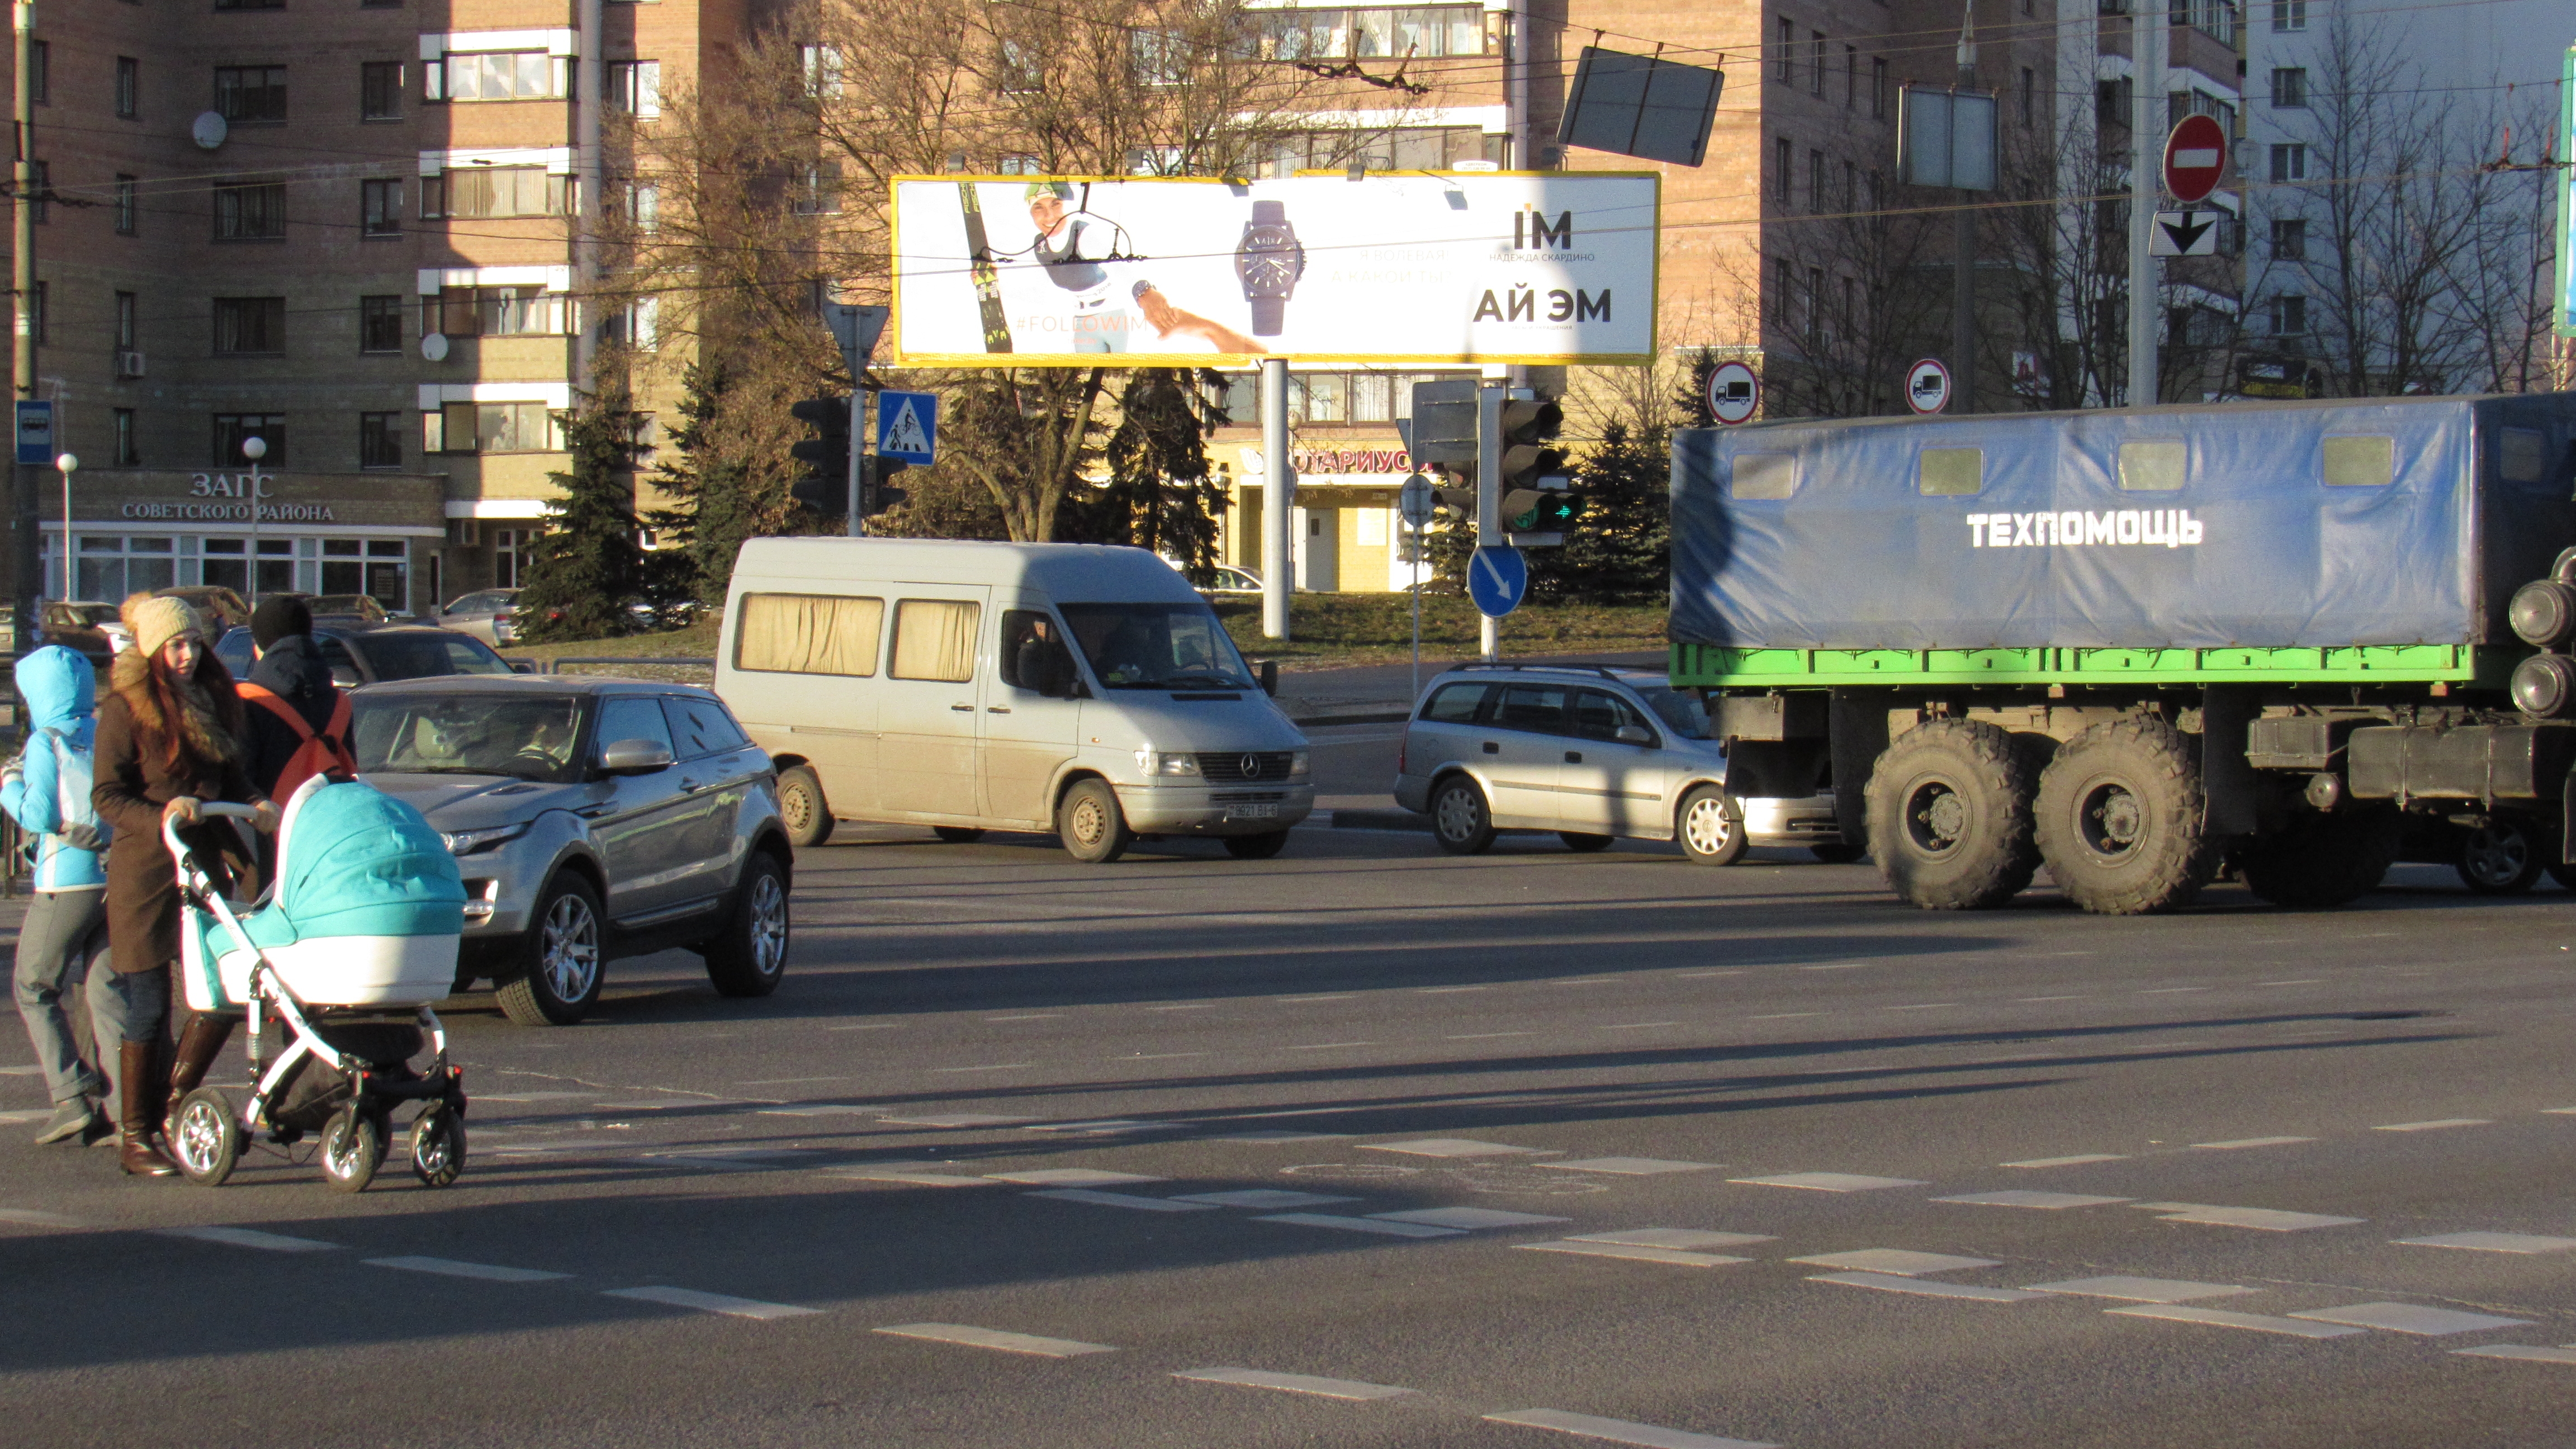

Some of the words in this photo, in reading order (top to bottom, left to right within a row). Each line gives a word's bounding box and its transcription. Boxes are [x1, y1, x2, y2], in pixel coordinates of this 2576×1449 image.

[1489, 254, 1538, 262] НАДЕЖДА
[1542, 253, 1595, 263] СКАРДИНО
[1472, 282, 1535, 322] АЙ
[1547, 288, 1611, 323] ЭМ
[1016, 316, 1147, 333] #FOLLOWIM
[1288, 449, 1434, 473] ОТАРИУС
[190, 473, 275, 499] ЗАГС
[122, 503, 249, 519] СОВЕТСКОГО
[255, 503, 335, 520] РАЙОНА
[1966, 509, 2204, 548] ТЕХПОМОЩЬ
